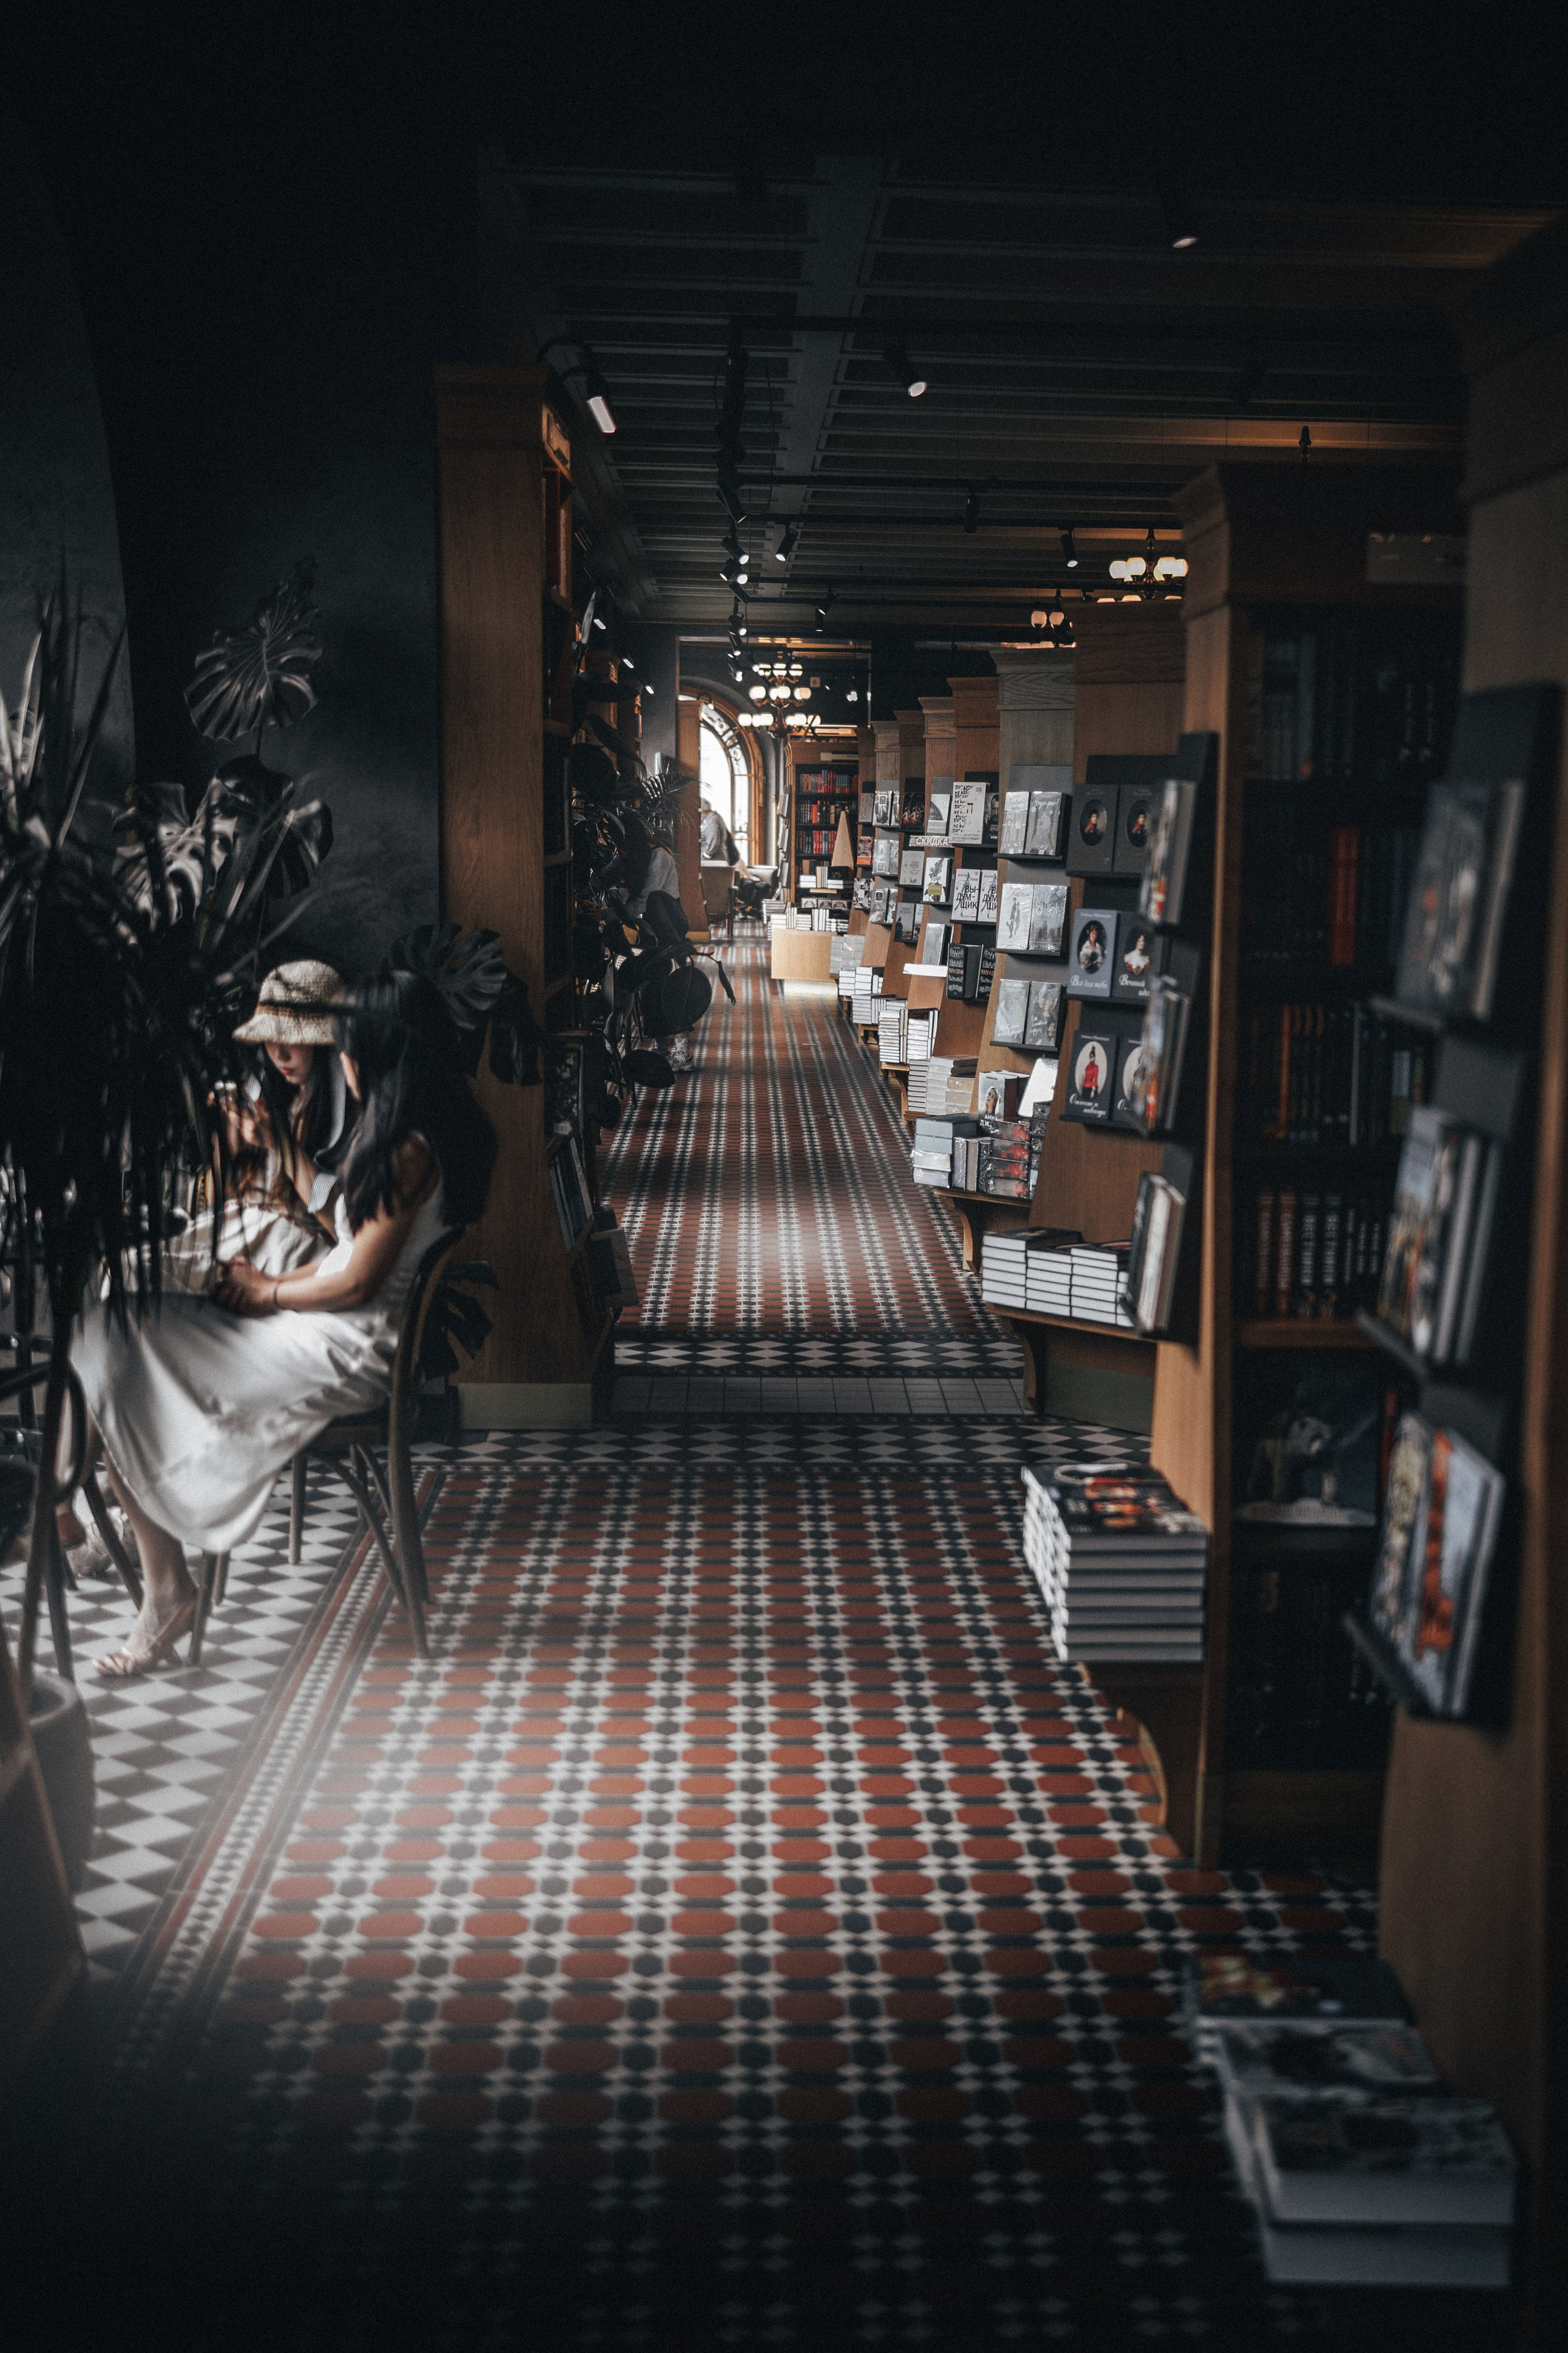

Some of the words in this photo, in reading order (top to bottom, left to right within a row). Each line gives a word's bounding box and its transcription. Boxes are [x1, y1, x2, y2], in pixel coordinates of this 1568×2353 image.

[916, 837, 949, 847] СКИДКА
[956, 893, 975, 902] ДУМ-
[960, 901, 978, 910] ЩИК
